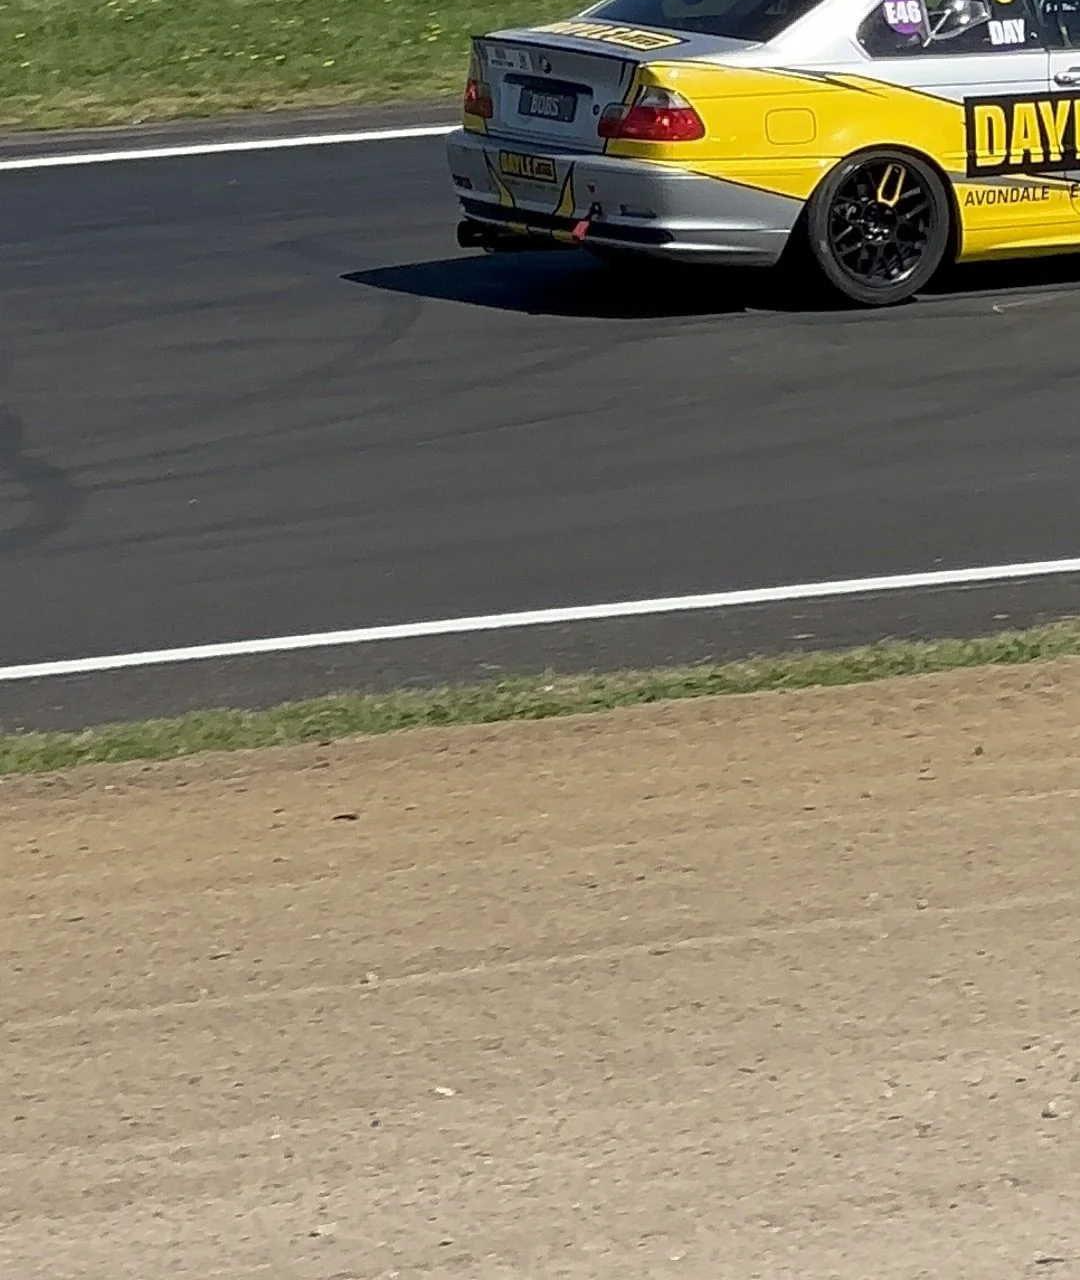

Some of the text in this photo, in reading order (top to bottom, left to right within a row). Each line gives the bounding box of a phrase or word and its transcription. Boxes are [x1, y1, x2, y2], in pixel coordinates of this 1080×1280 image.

[884, 1, 921, 25] E46
[988, 19, 1026, 45] DAY
[964, 185, 1050, 207] AVONDALE
